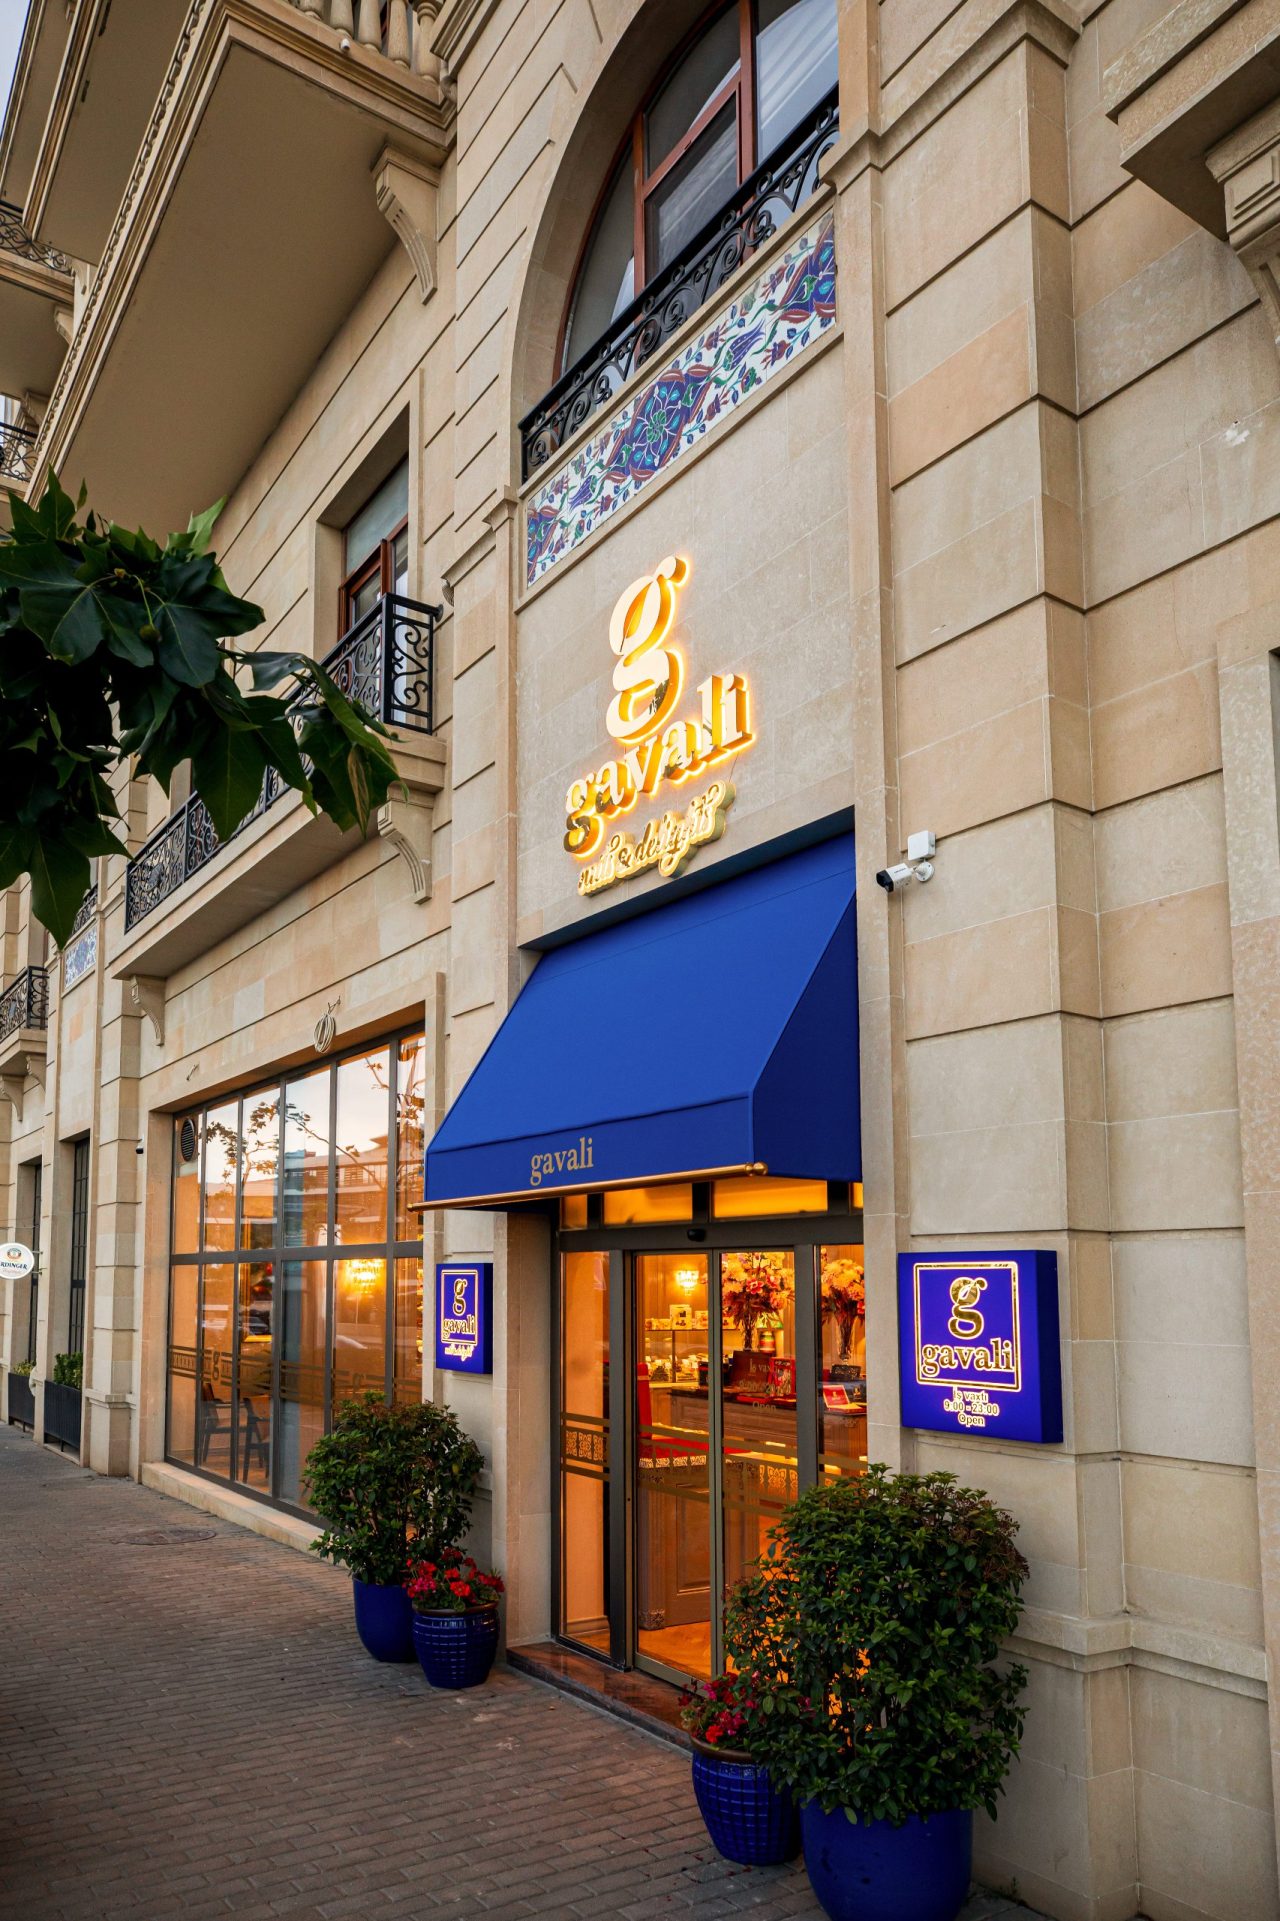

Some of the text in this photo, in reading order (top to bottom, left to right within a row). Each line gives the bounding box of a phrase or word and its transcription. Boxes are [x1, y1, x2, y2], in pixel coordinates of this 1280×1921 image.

[606, 556, 686, 741] g
[564, 672, 751, 857] gavali
[529, 1136, 594, 1187] gavali
[453, 1278, 468, 1316] g
[948, 1277, 988, 1340] g
[442, 1314, 476, 1340] gavali
[921, 1337, 1016, 1378] gavali
[957, 1411, 986, 1427] Open
